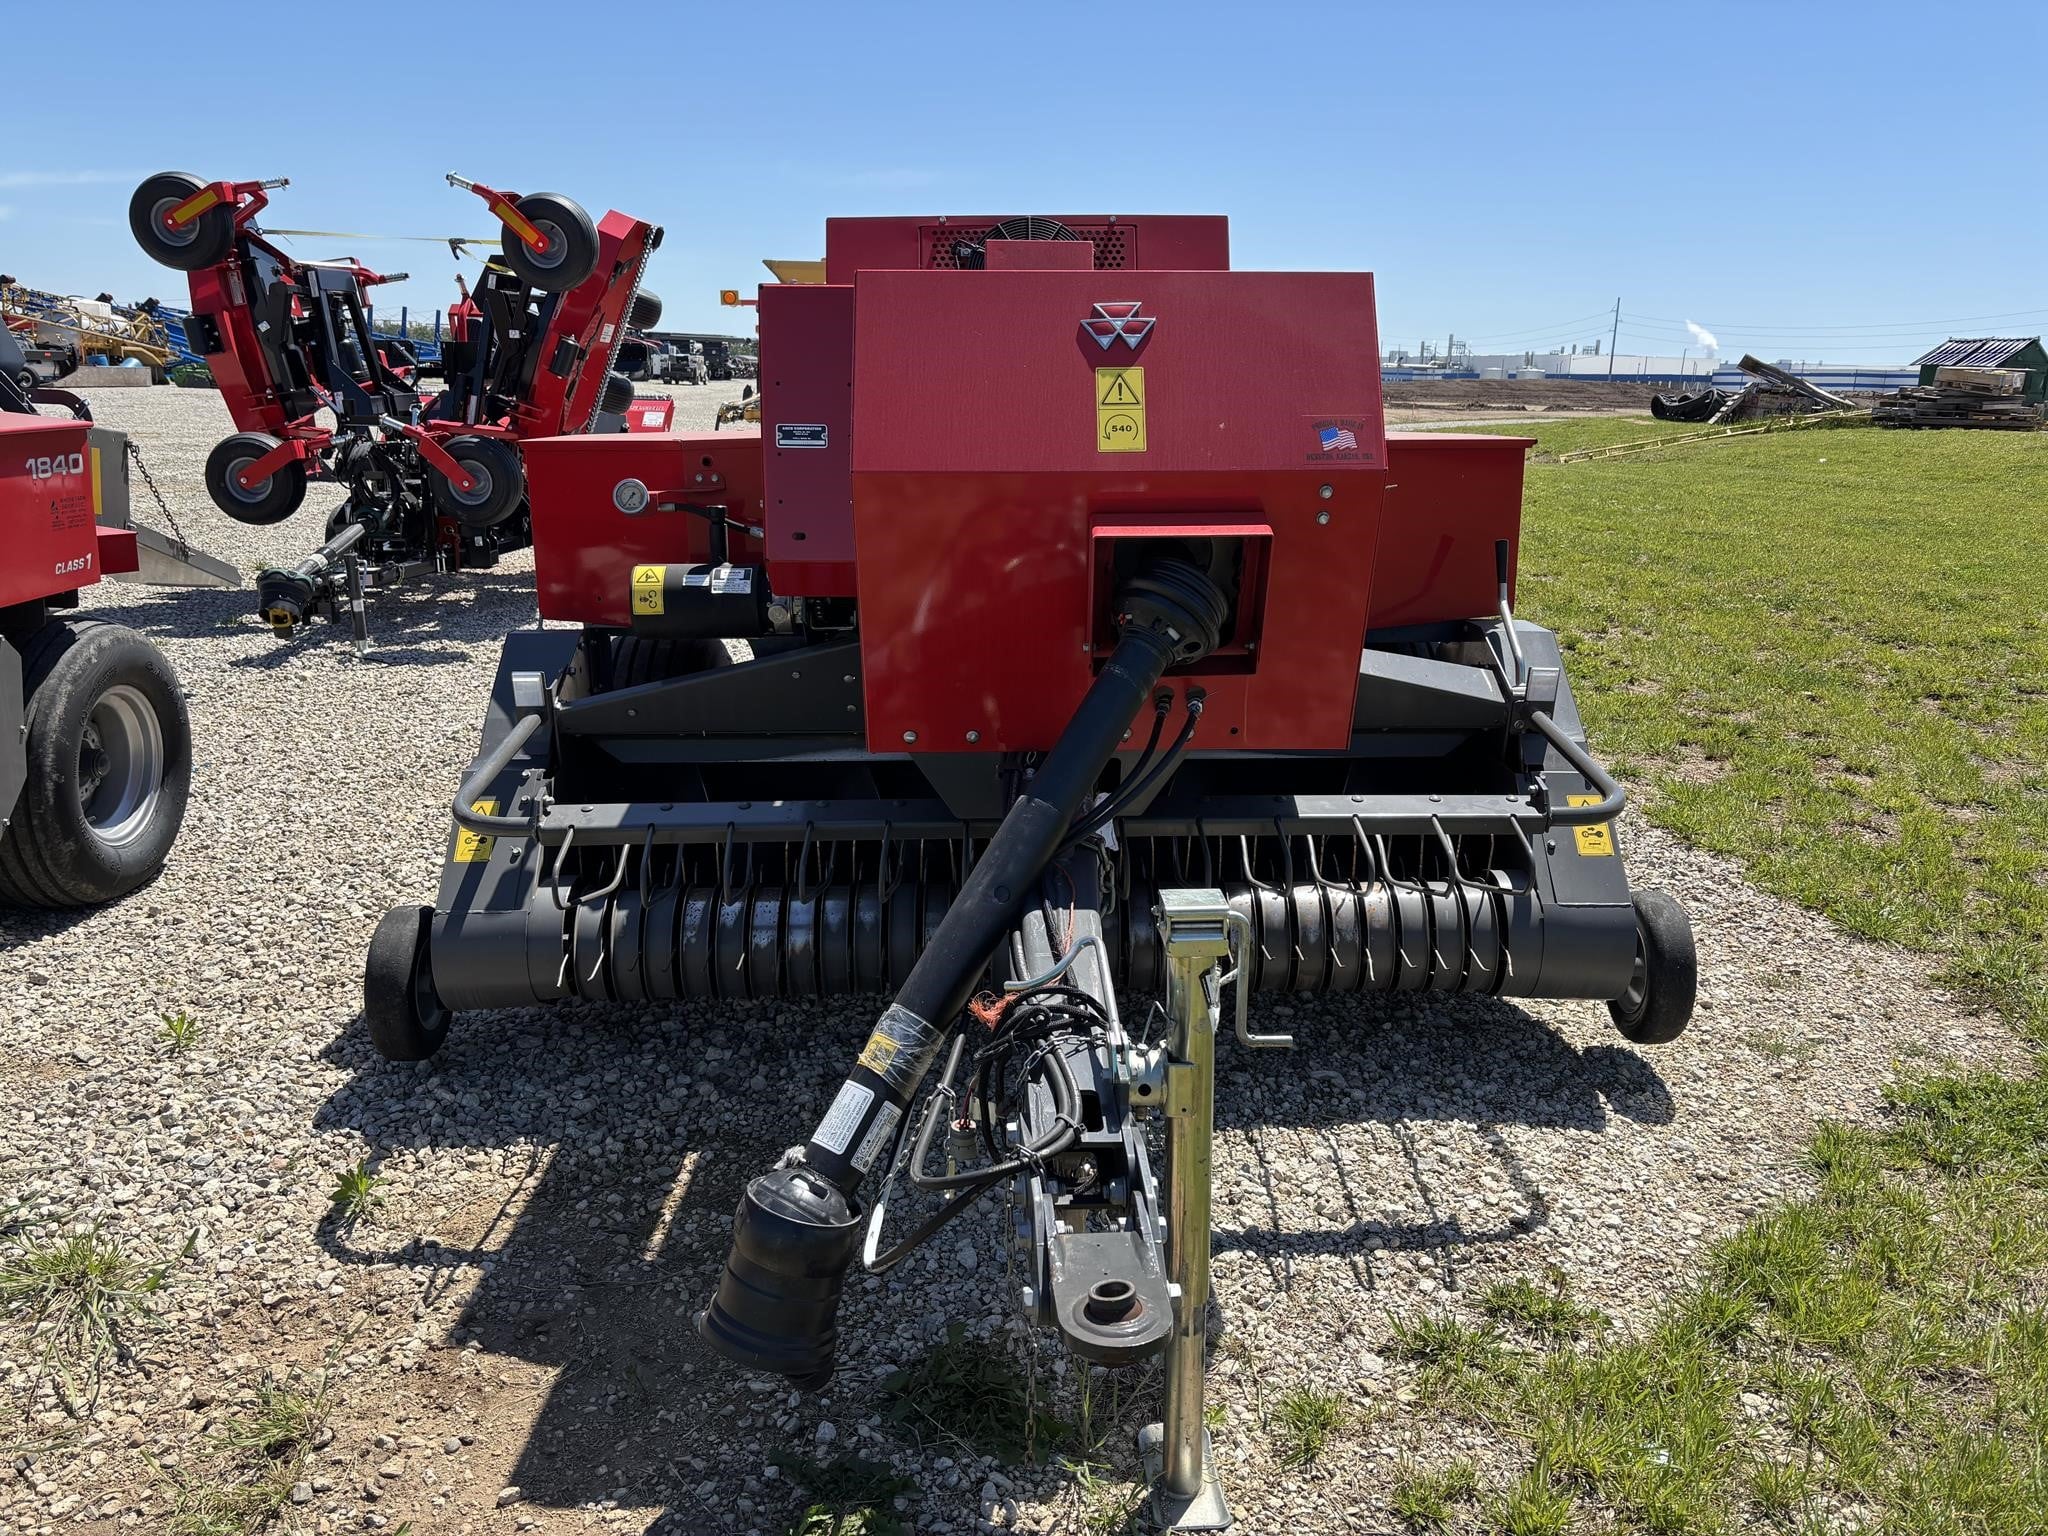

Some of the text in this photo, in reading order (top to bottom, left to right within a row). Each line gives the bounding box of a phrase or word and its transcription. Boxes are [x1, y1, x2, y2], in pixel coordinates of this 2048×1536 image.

[26, 453, 83, 480] 1840
[55, 552, 92, 575] CLASS 1
